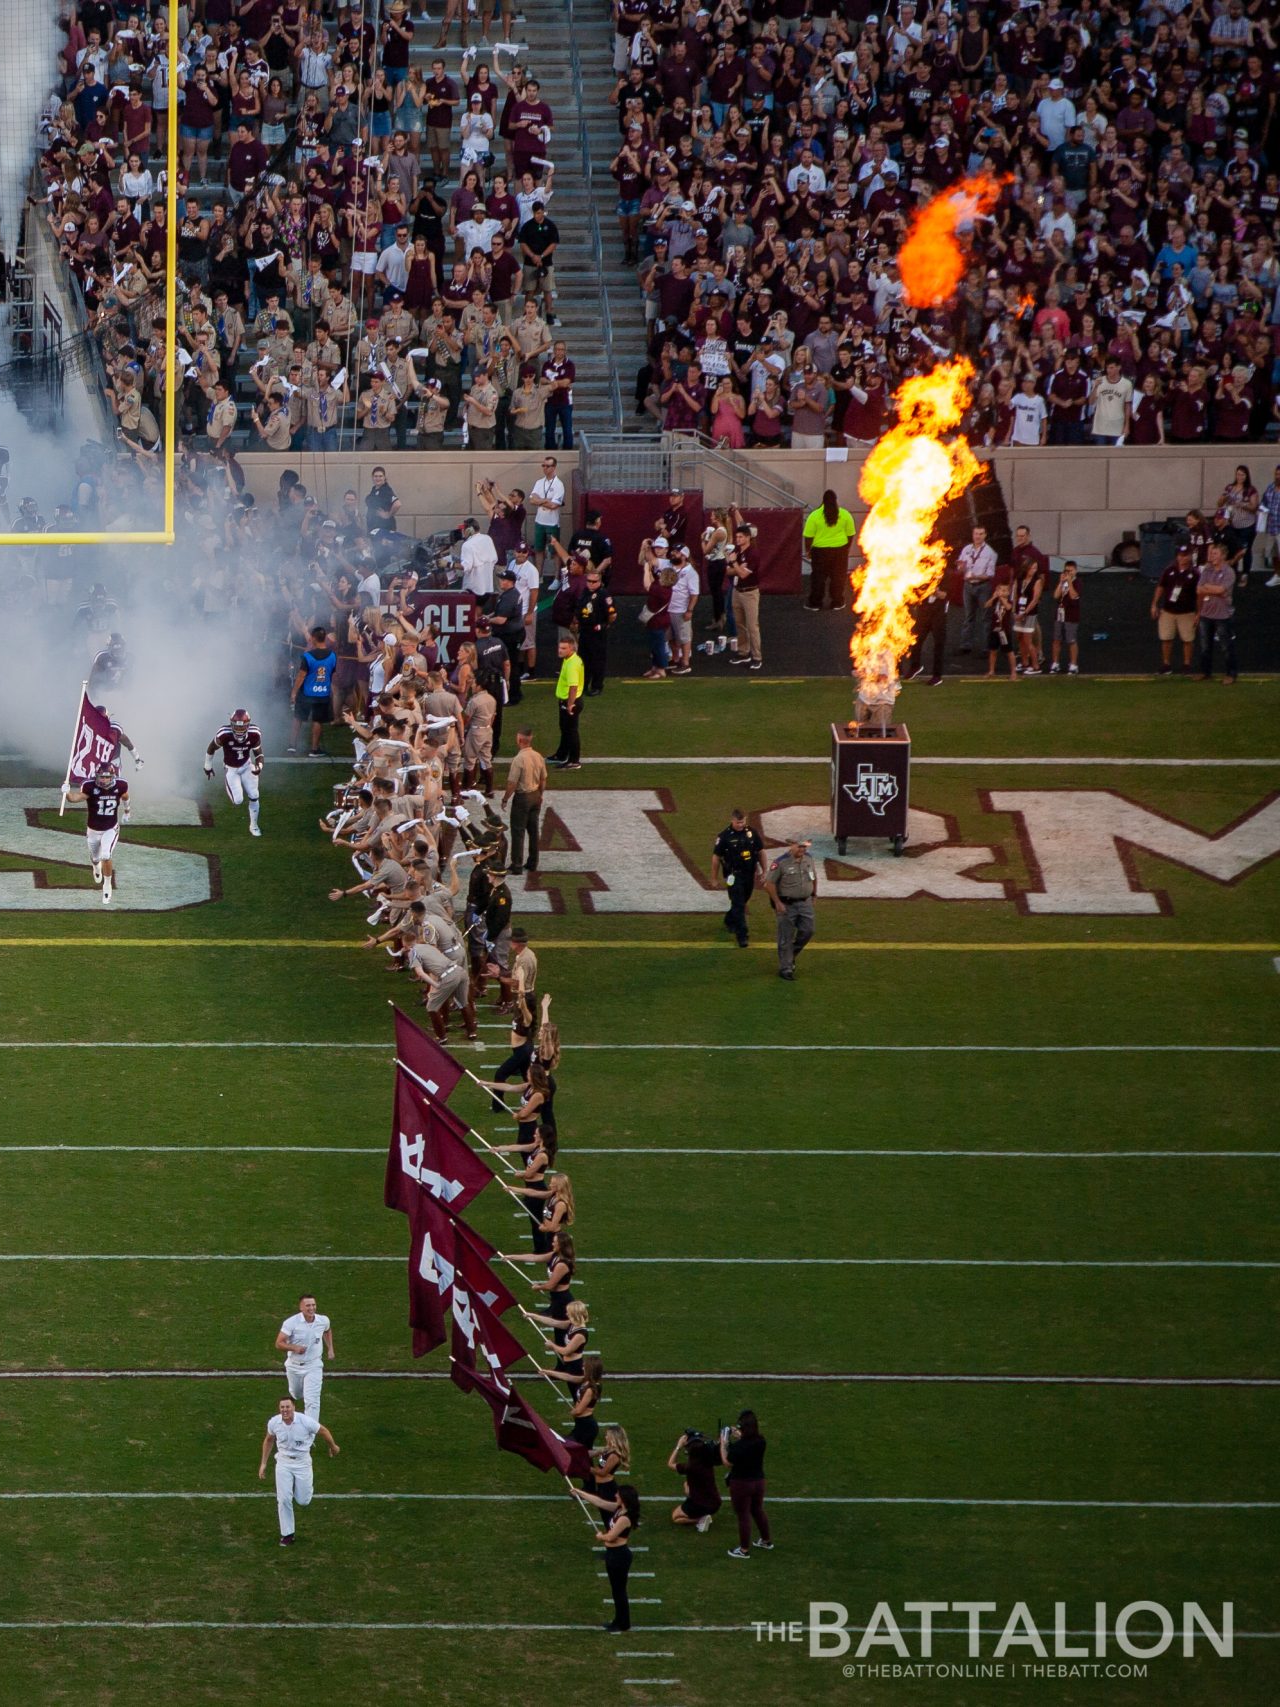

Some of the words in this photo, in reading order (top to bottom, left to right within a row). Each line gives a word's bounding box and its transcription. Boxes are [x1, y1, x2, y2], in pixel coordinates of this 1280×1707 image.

[704, 375, 717, 389] 12
[236, 750, 245, 760] 1
[97, 800, 117, 816] 12
